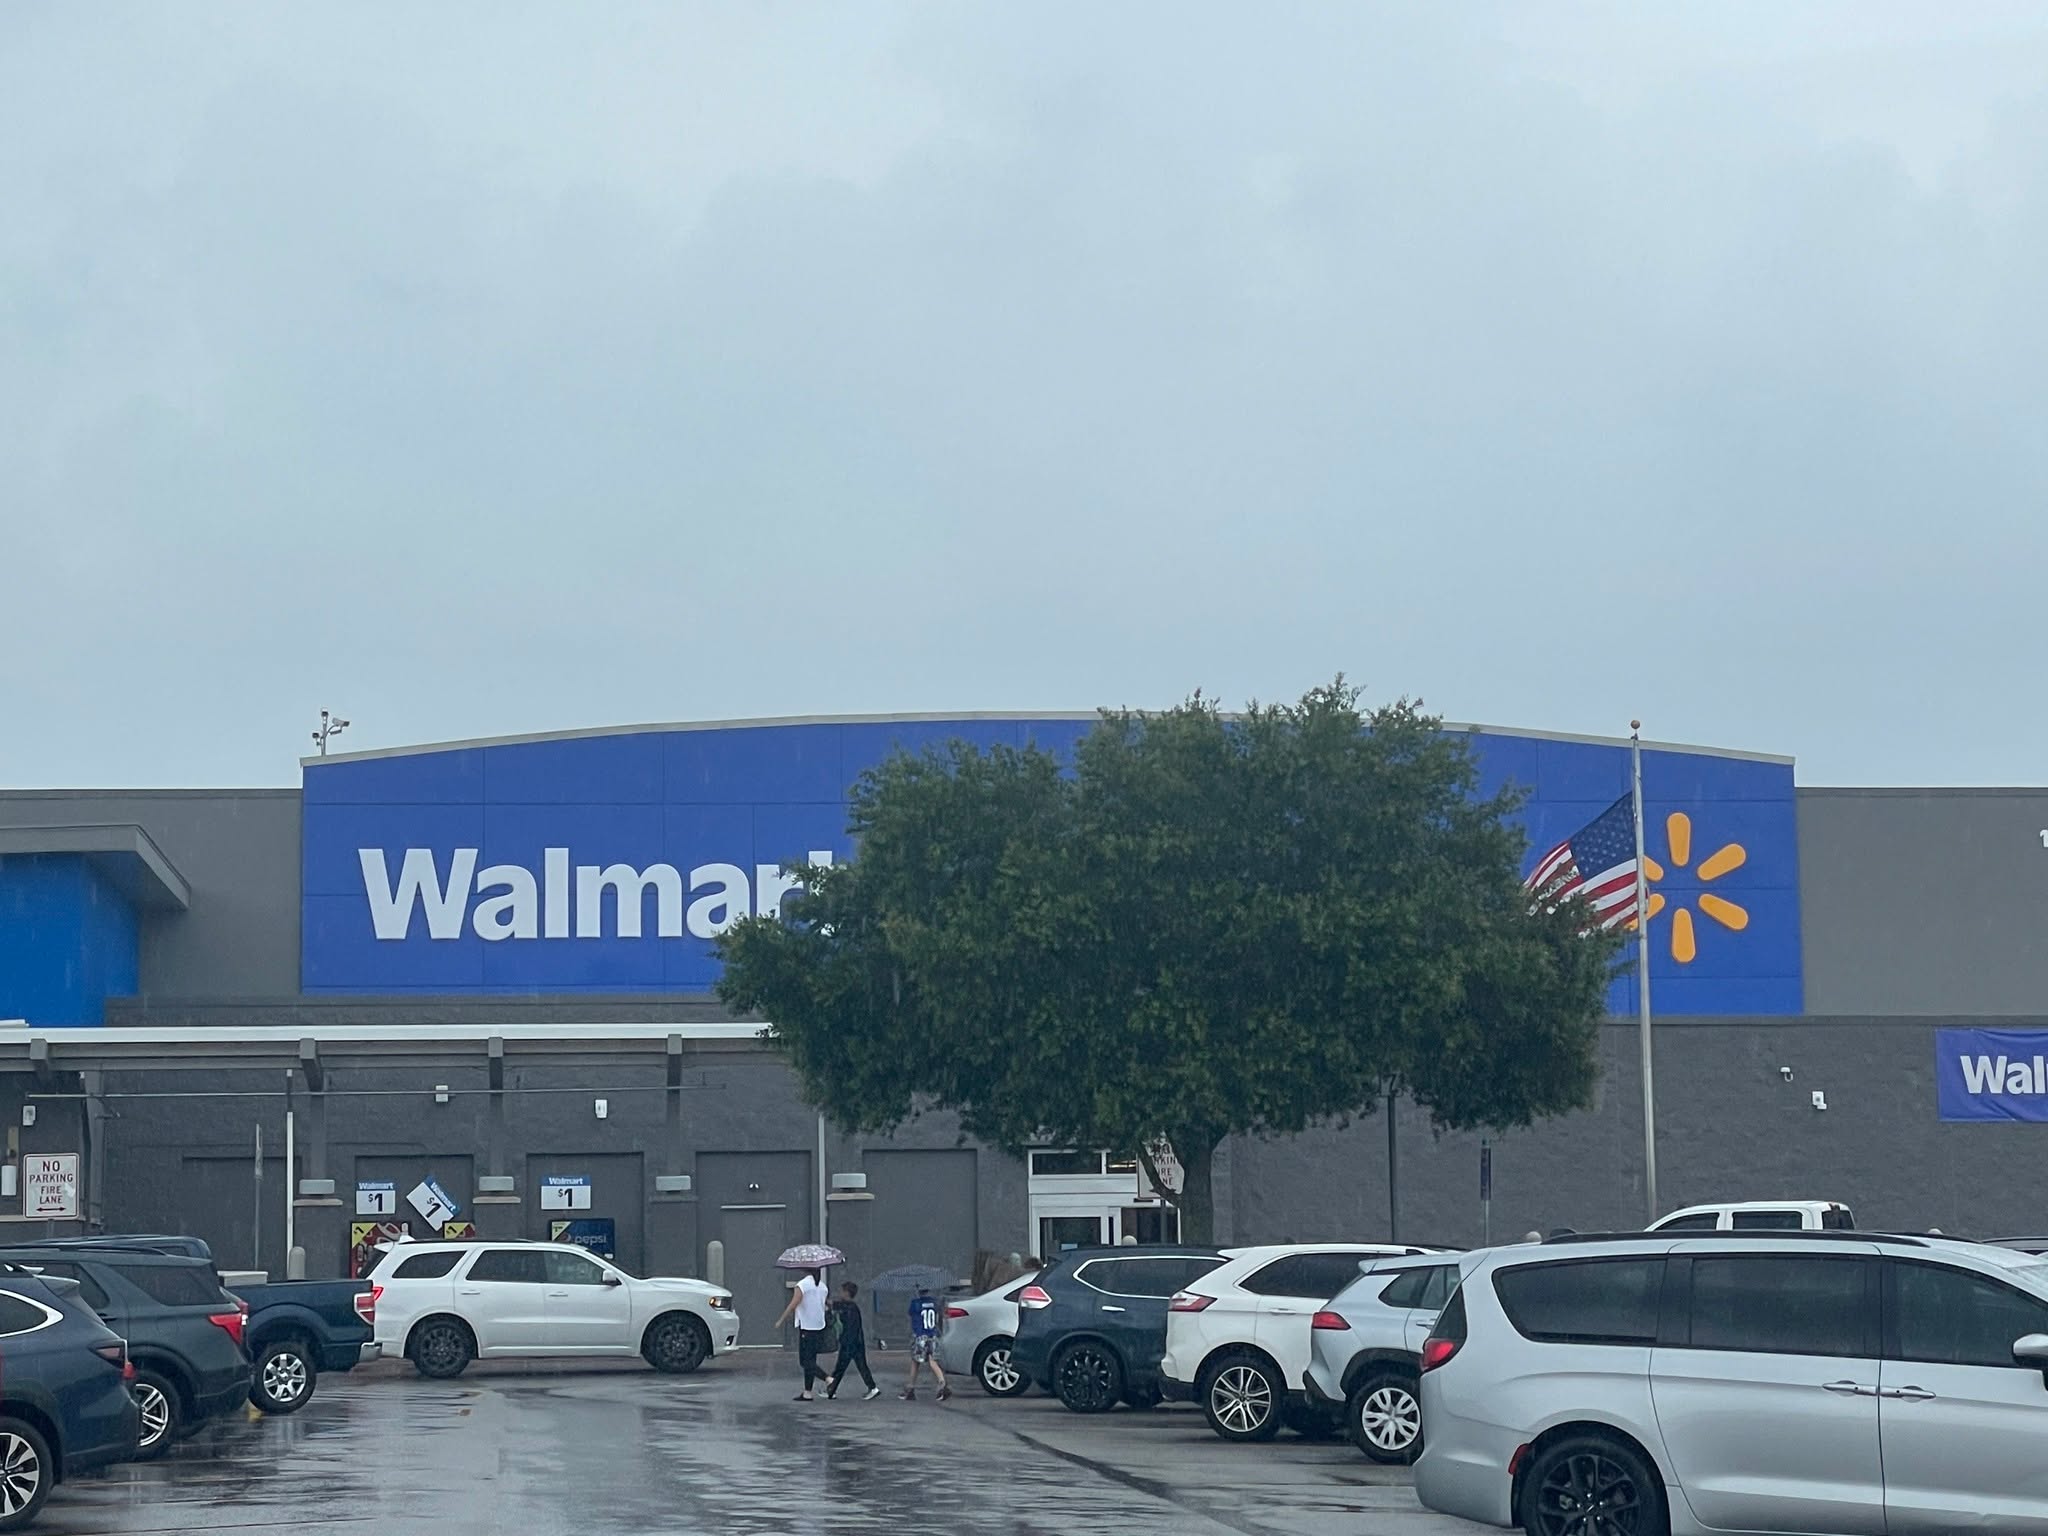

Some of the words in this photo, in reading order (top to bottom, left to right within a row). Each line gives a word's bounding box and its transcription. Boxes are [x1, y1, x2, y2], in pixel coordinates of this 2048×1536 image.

[1959, 1055, 2048, 1095] Wal
[42, 1160, 60, 1172] NO
[29, 1173, 74, 1185] PARKING
[548, 1177, 584, 1185] Walmart
[41, 1185, 62, 1195] FIRE
[358, 1182, 394, 1190] Walmart
[39, 1195, 63, 1205] LANE
[367, 1193, 383, 1212] $1
[557, 1188, 573, 1208] $1
[426, 1197, 442, 1219] $1
[921, 1309, 935, 1329] 10
